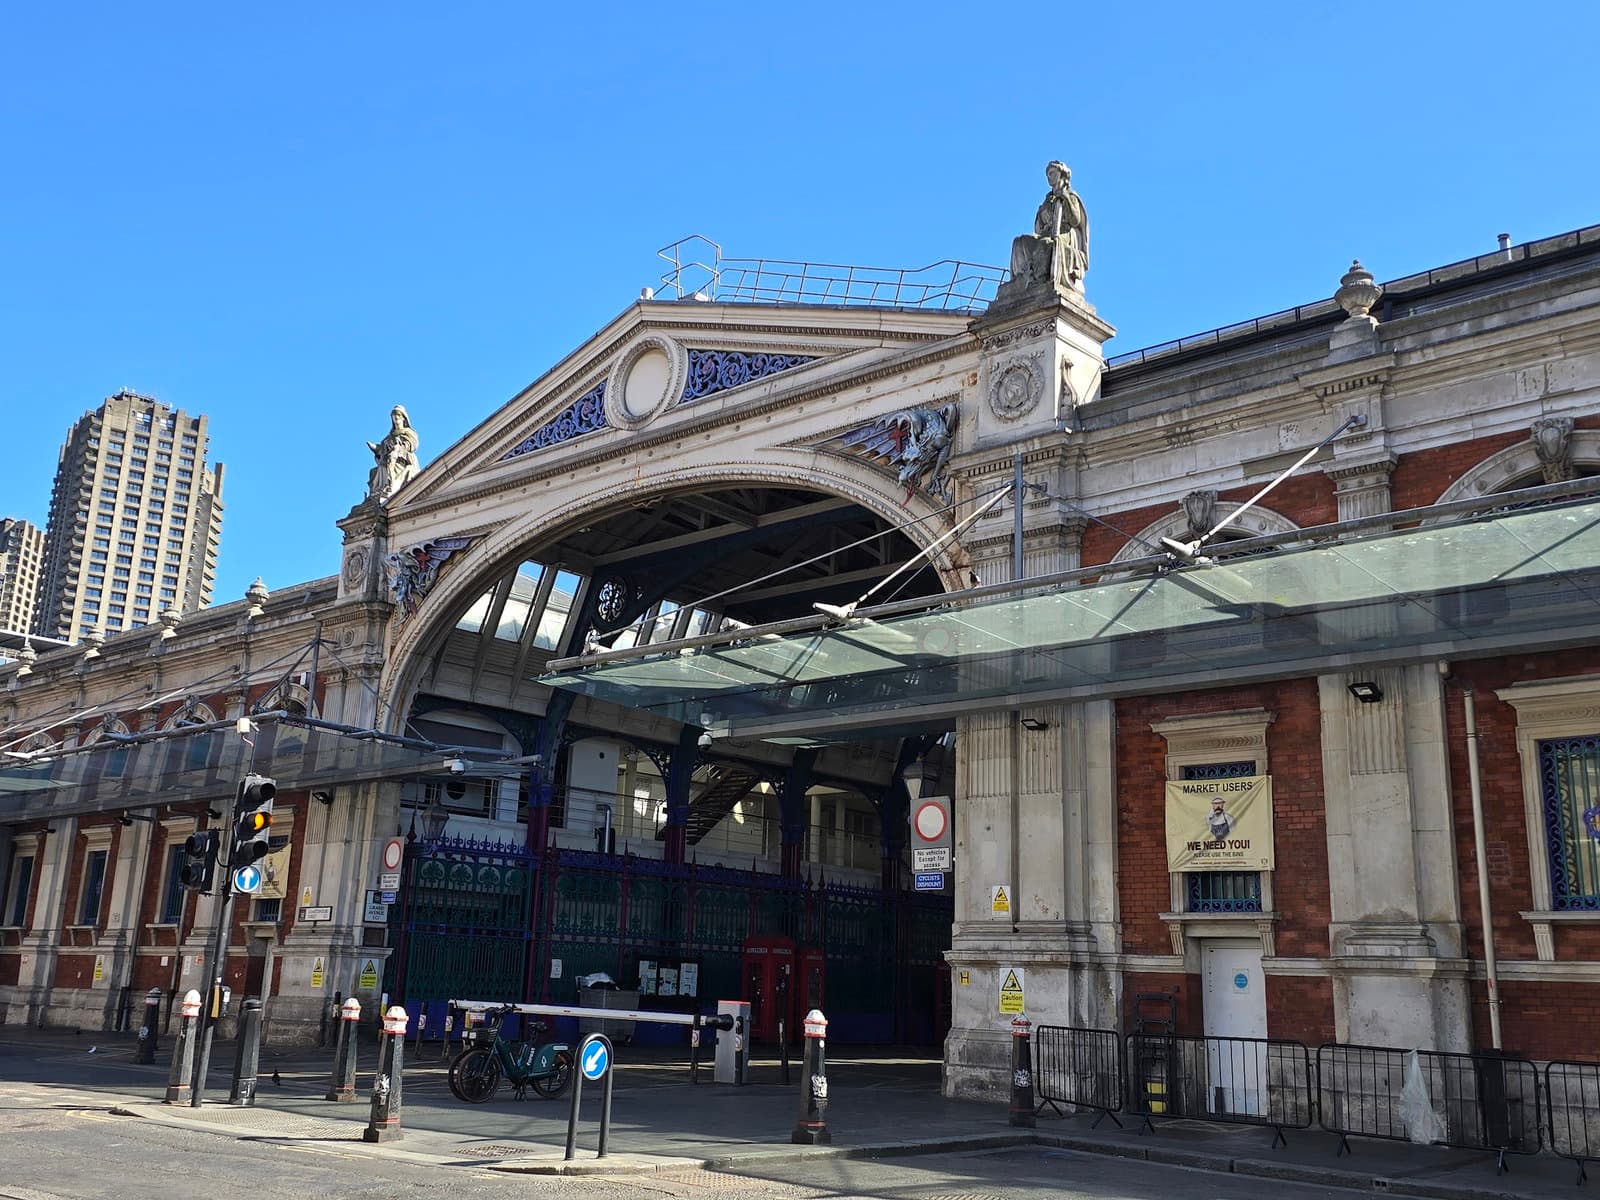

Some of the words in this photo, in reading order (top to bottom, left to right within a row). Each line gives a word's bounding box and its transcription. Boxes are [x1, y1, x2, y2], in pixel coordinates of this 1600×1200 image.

[1183, 784, 1220, 794] MARKET
[1223, 782, 1252, 792] USERS
[1187, 841, 1200, 850] WE
[1203, 840, 1226, 850] NEED
[1228, 840, 1250, 849] YOU!
